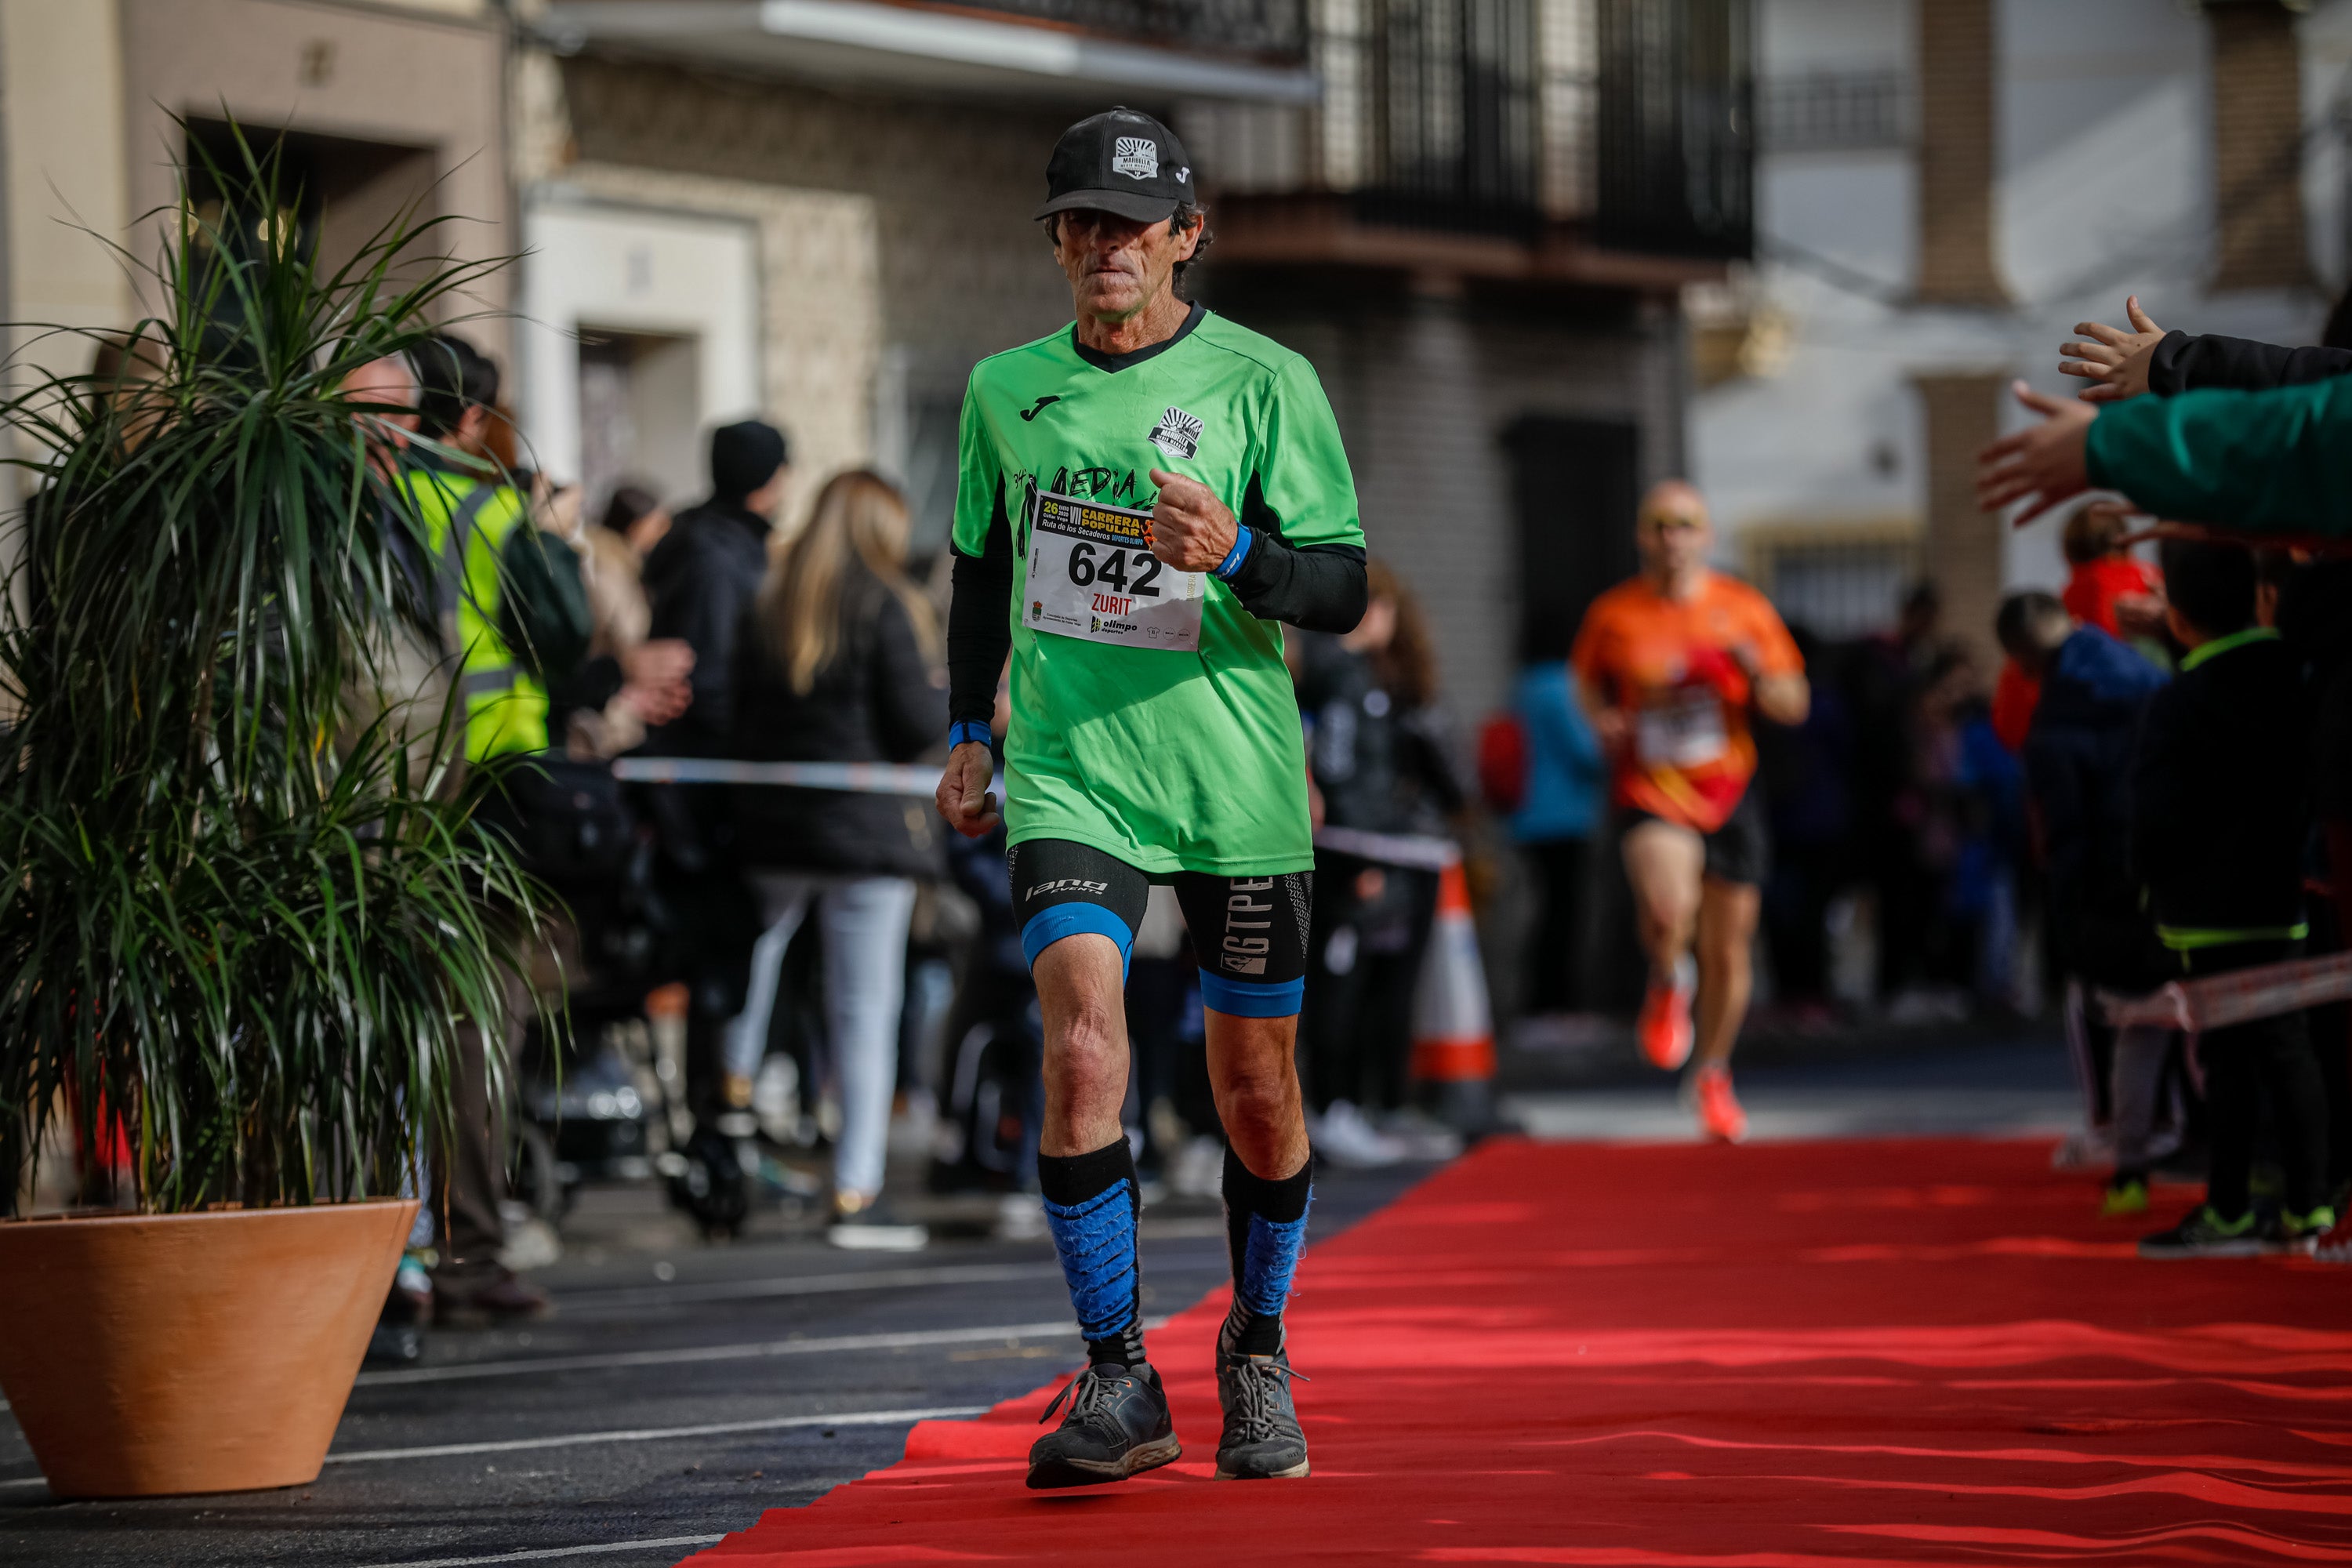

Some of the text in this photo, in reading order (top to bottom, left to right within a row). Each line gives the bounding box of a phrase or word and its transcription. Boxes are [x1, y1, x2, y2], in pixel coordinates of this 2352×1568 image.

[1160, 429, 1189, 448] MARBELLA
[1044, 501, 1058, 514] 26
[1069, 506, 1082, 525] VII
[1081, 518, 1139, 536] POPULAR
[1082, 508, 1140, 528] CARRERA
[1042, 519, 1057, 528] Ruta
[1057, 522, 1066, 531] de
[1066, 524, 1076, 533] los
[1077, 527, 1110, 540] Secaderos
[1111, 534, 1129, 544] DEPORTES
[1069, 542, 1162, 597] 642
[1091, 593, 1132, 616] ZURIT
[1103, 619, 1138, 632] olimpo
[1025, 879, 1108, 902] land
